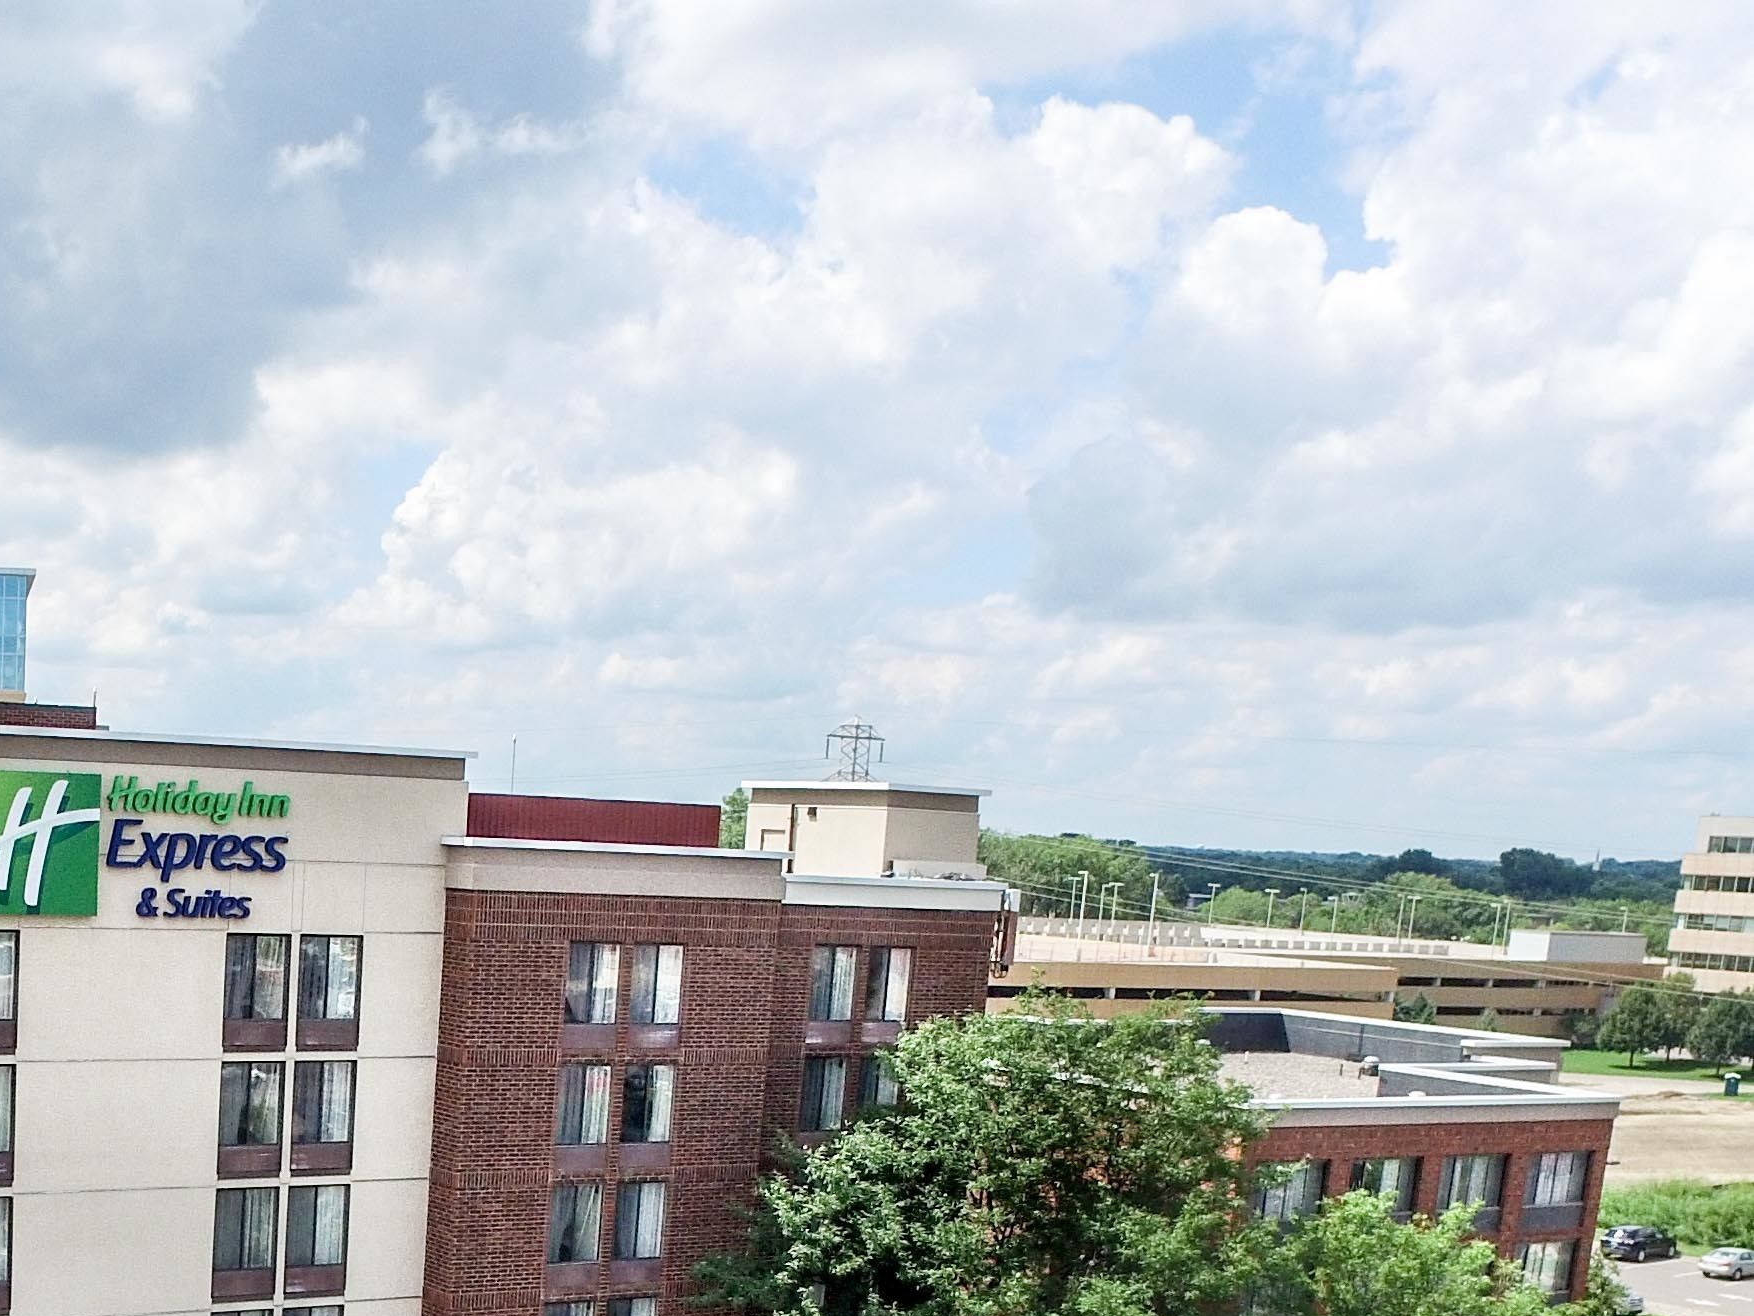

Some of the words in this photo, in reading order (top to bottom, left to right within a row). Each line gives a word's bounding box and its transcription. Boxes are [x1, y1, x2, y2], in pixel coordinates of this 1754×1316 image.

[106, 775, 237, 825] Holiday
[238, 781, 291, 818] Inn
[106, 818, 289, 882] Express
[135, 887, 158, 918] &
[163, 888, 252, 920] Suites
